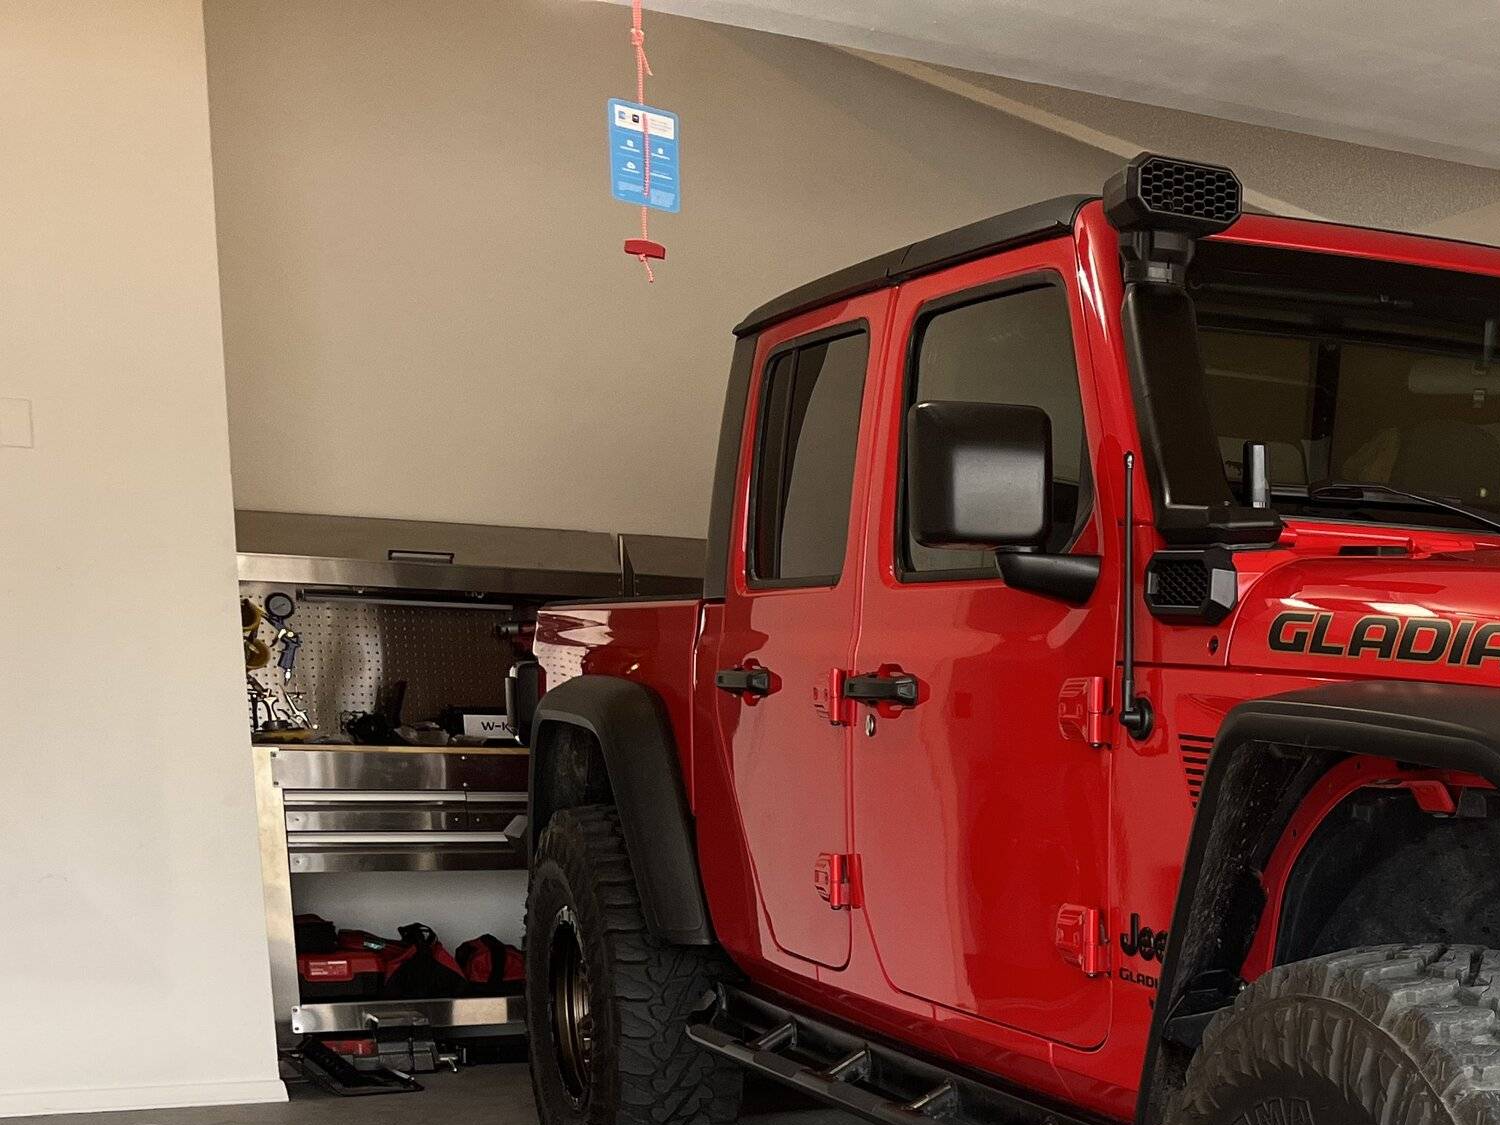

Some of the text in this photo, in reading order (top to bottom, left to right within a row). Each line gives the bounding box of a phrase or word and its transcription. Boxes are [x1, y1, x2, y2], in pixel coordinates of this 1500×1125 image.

[481, 721, 511, 733] W-K
[1120, 912, 1168, 964] Jee
[1119, 967, 1159, 989] GLADI
